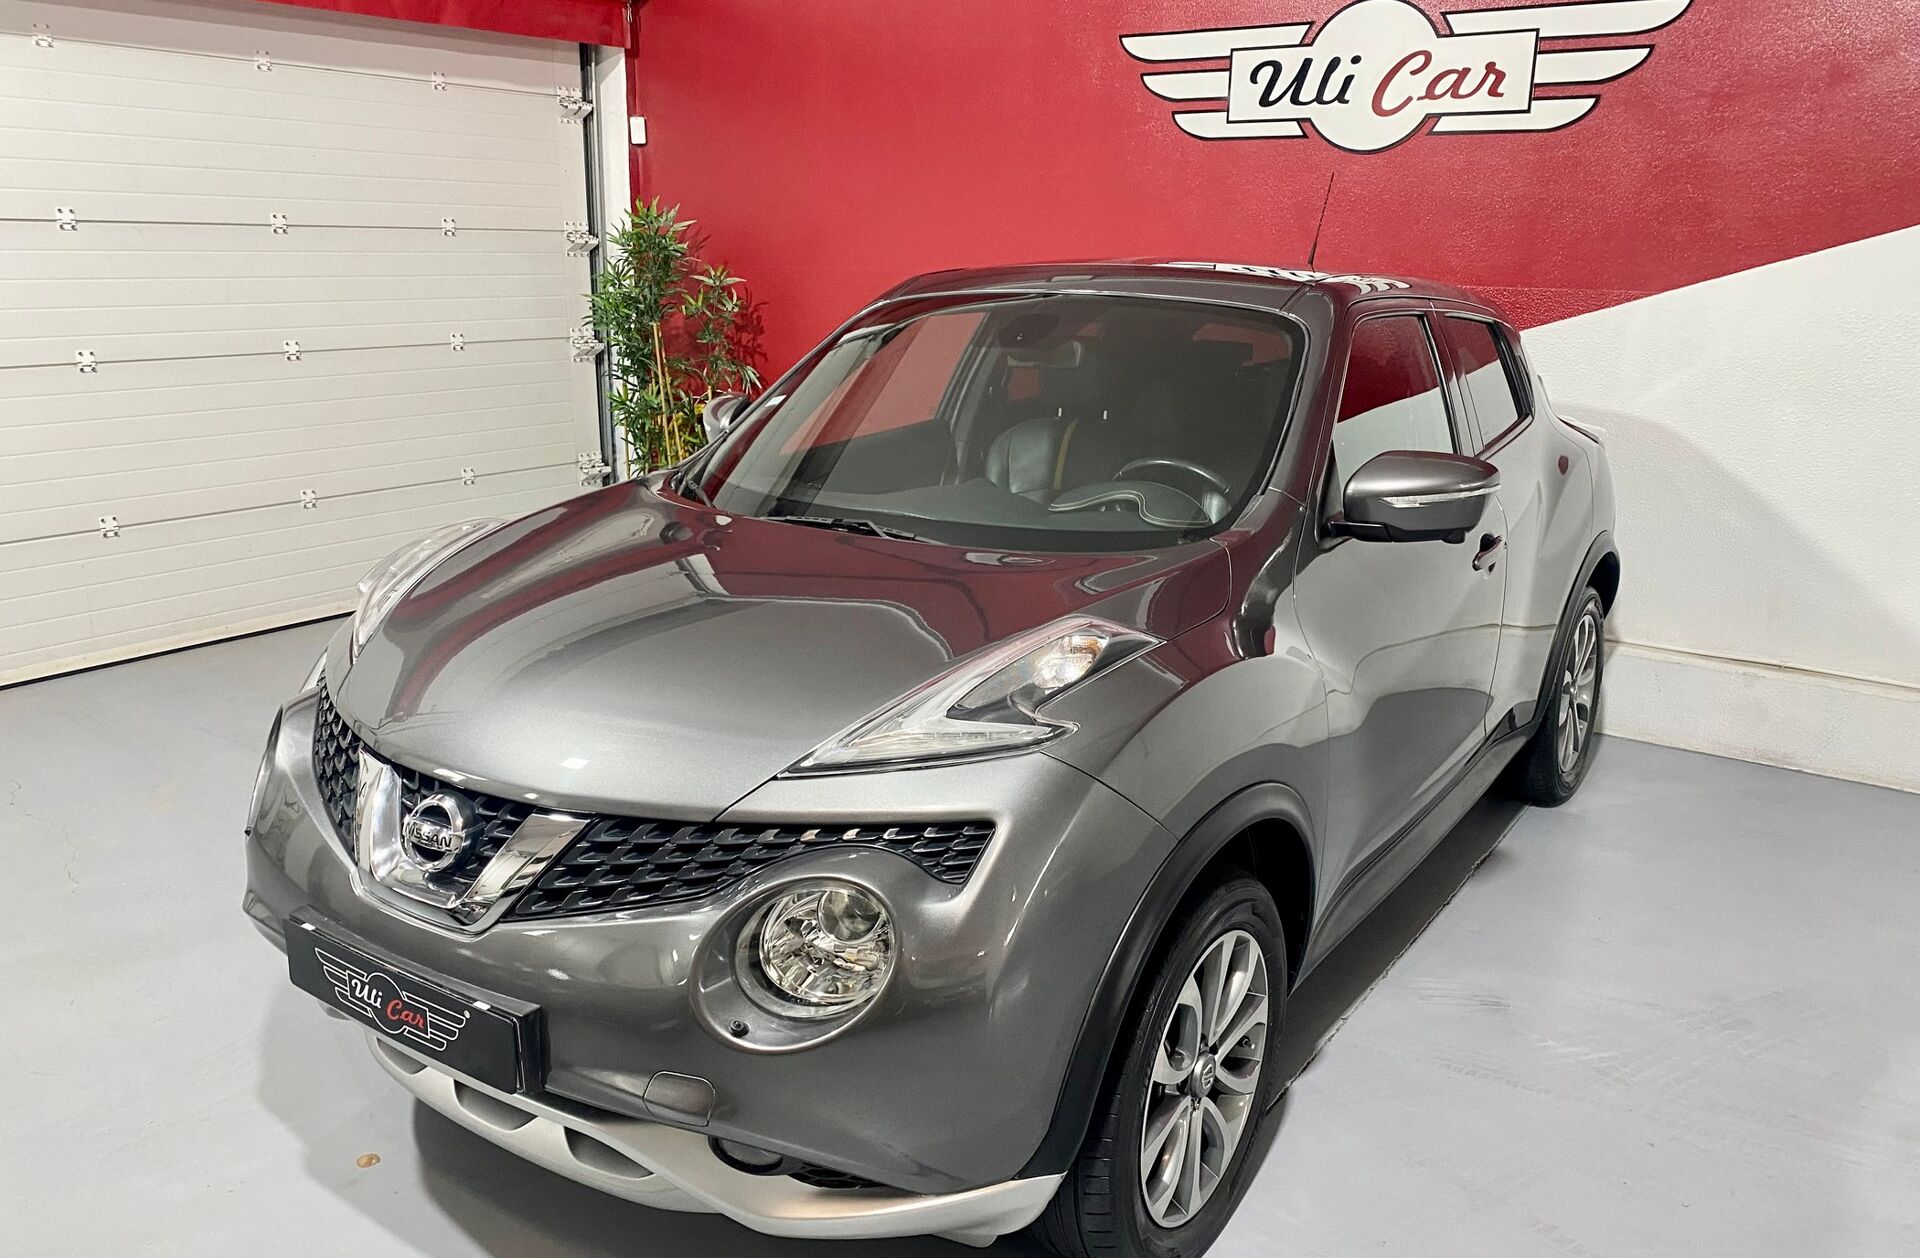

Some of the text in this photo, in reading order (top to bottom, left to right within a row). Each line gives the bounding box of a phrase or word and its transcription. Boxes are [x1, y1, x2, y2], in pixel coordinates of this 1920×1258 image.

[1250, 50, 1506, 117] Uli Car
[407, 823, 453, 848] NISSAN
[352, 978, 425, 1028] Uli Car
